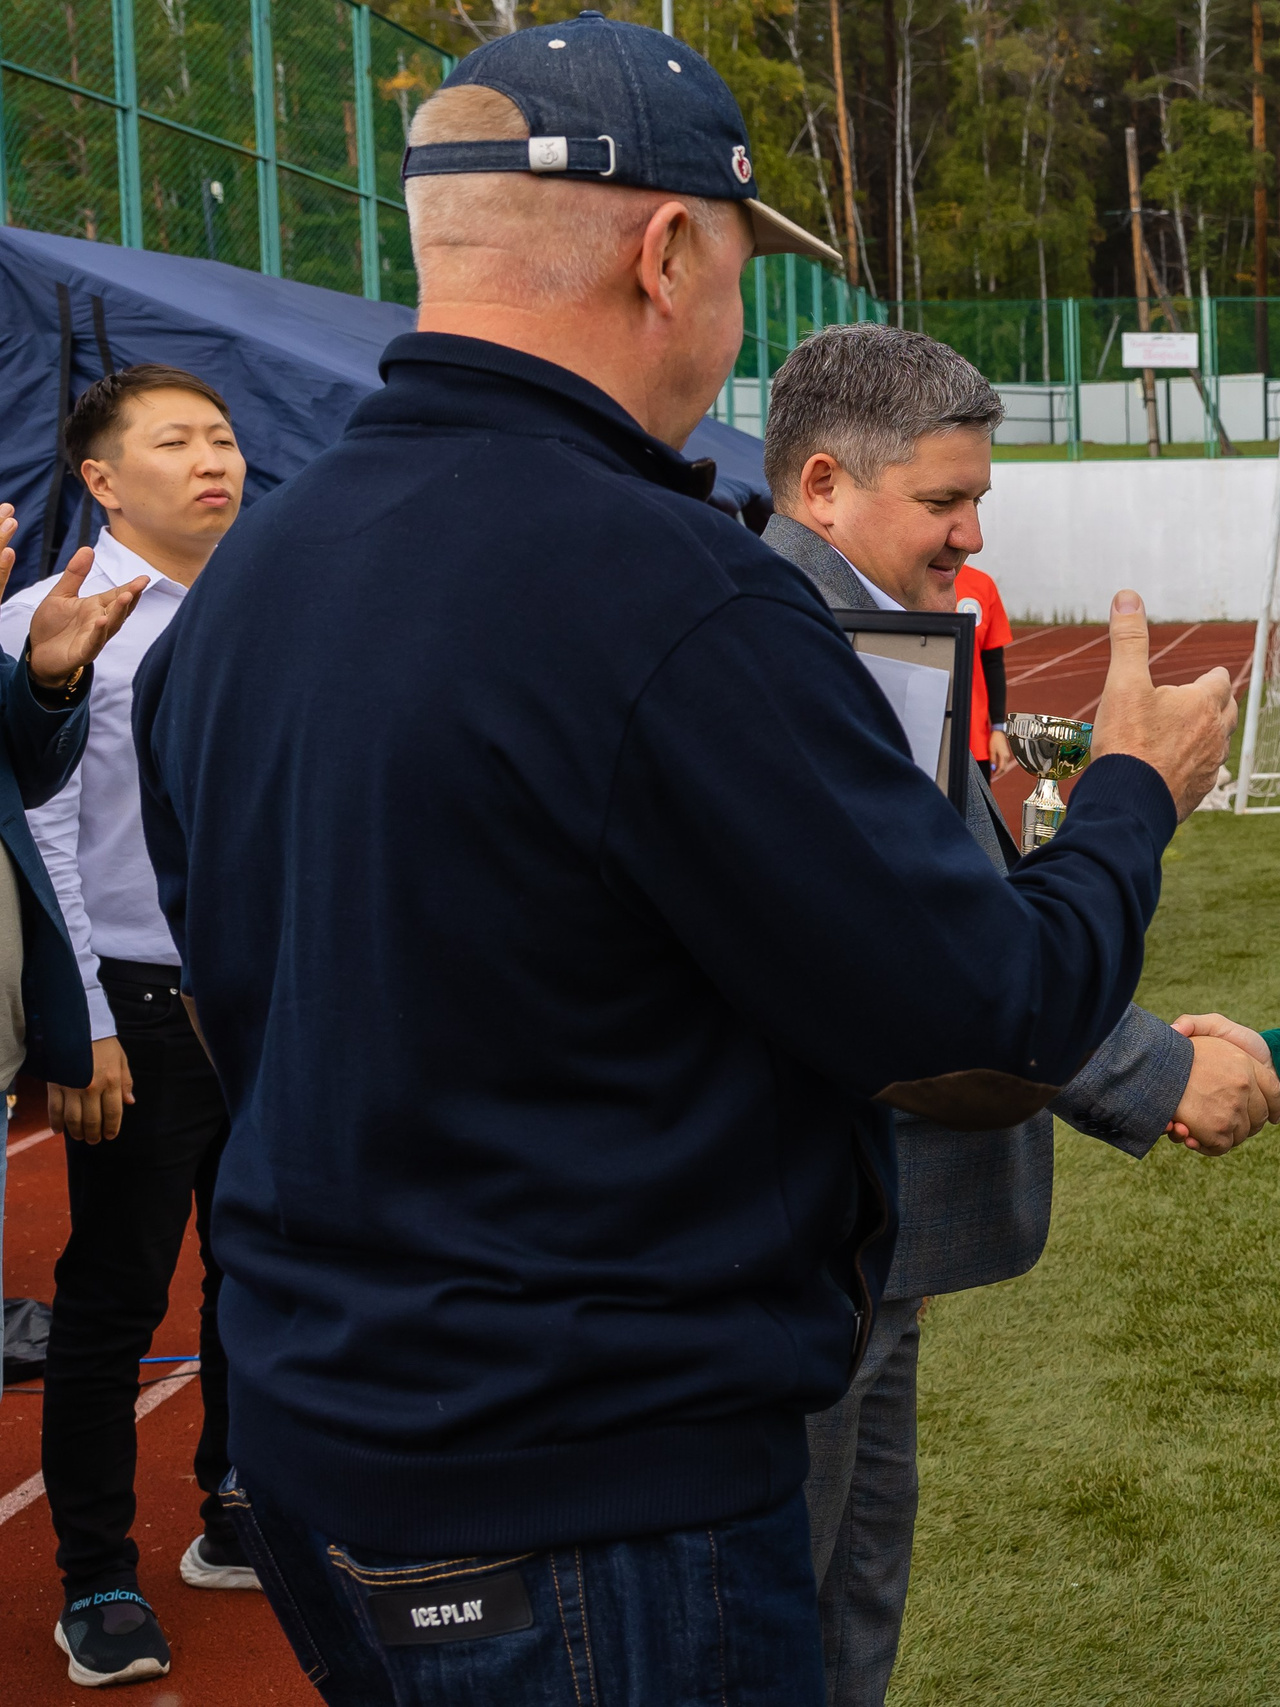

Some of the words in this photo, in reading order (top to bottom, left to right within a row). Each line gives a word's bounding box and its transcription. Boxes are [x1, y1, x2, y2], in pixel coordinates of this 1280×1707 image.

[70, 1596, 92, 1612] new
[411, 1606, 441, 1628] ICE
[440, 1599, 483, 1625] PLAY
